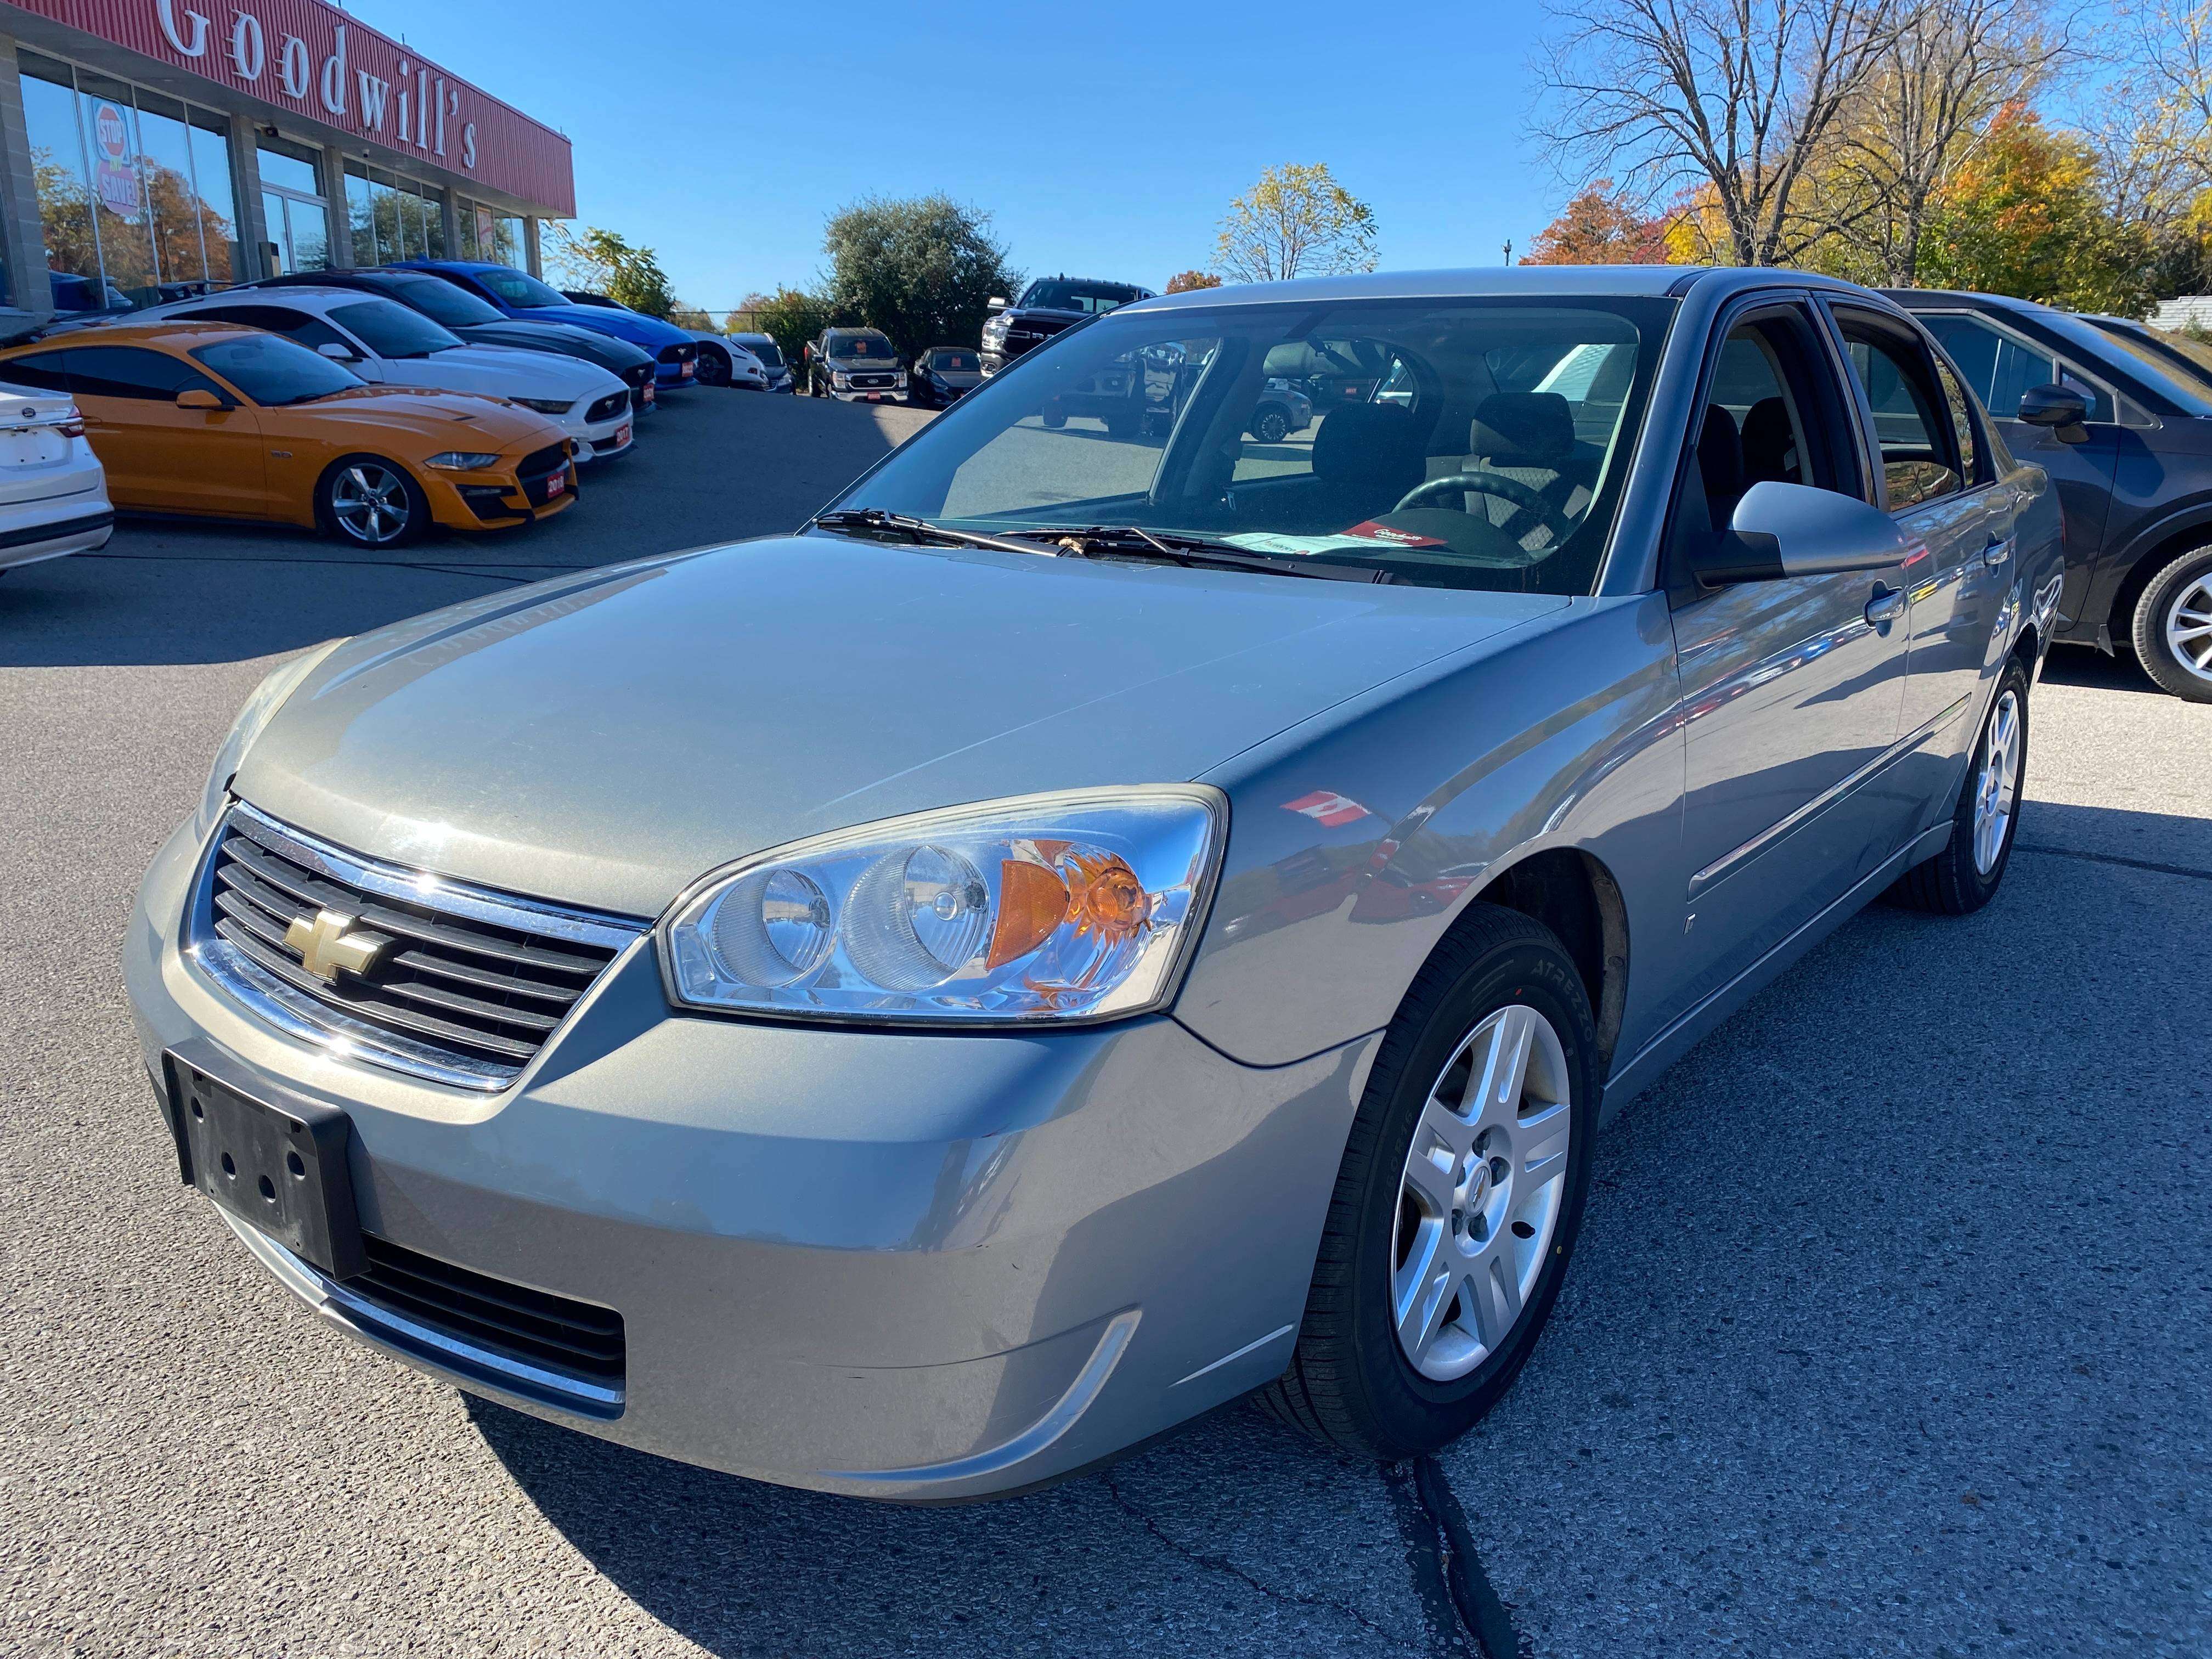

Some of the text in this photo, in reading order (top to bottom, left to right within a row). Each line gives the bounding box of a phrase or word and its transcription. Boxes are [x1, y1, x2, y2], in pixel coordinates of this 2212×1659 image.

[155, 0, 476, 169] Goodwill's
[99, 119, 123, 144] STOP
[101, 173, 137, 207] SAVE!
[617, 427, 629, 442] 2017
[1531, 959, 1593, 1042] ATREZZO
